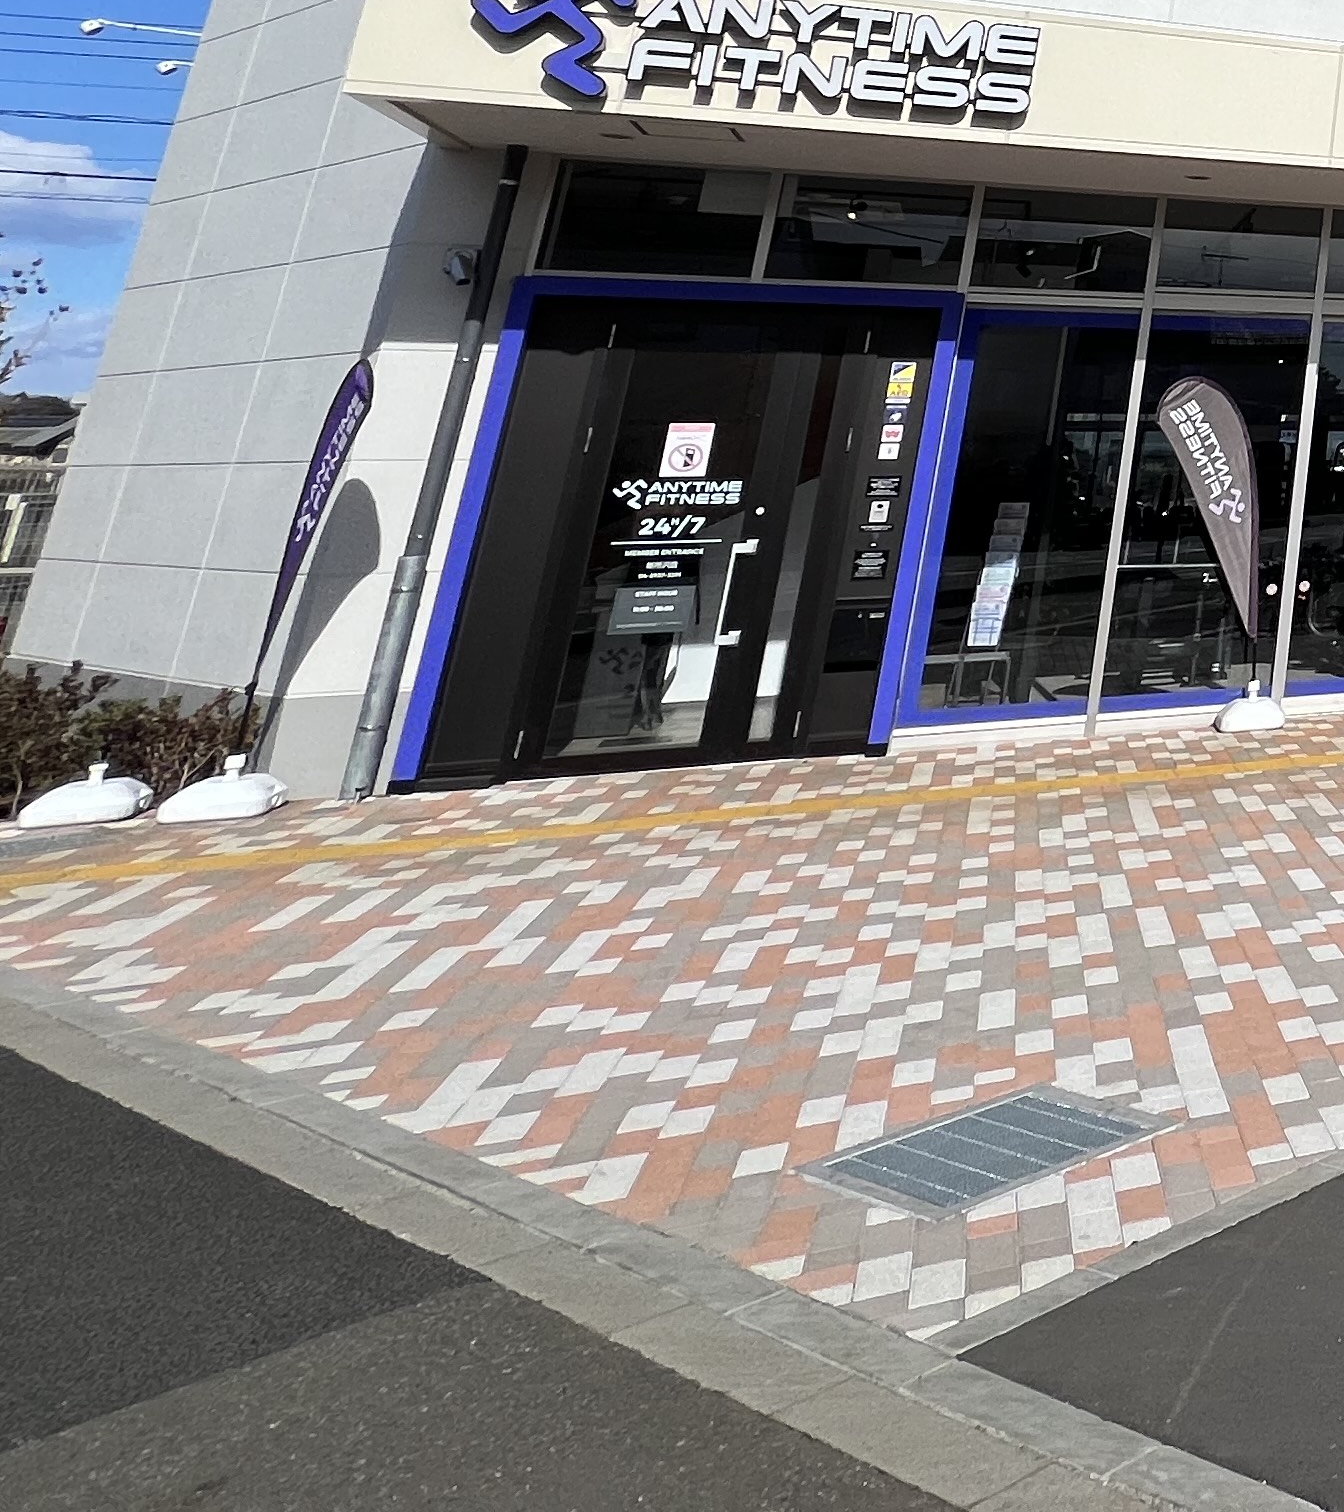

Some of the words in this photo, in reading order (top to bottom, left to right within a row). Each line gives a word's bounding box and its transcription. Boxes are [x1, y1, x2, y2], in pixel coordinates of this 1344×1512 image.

[625, 38, 1034, 116] FITNESS
[648, 480, 743, 493] ANYTIME
[644, 493, 740, 505] FITNESS
